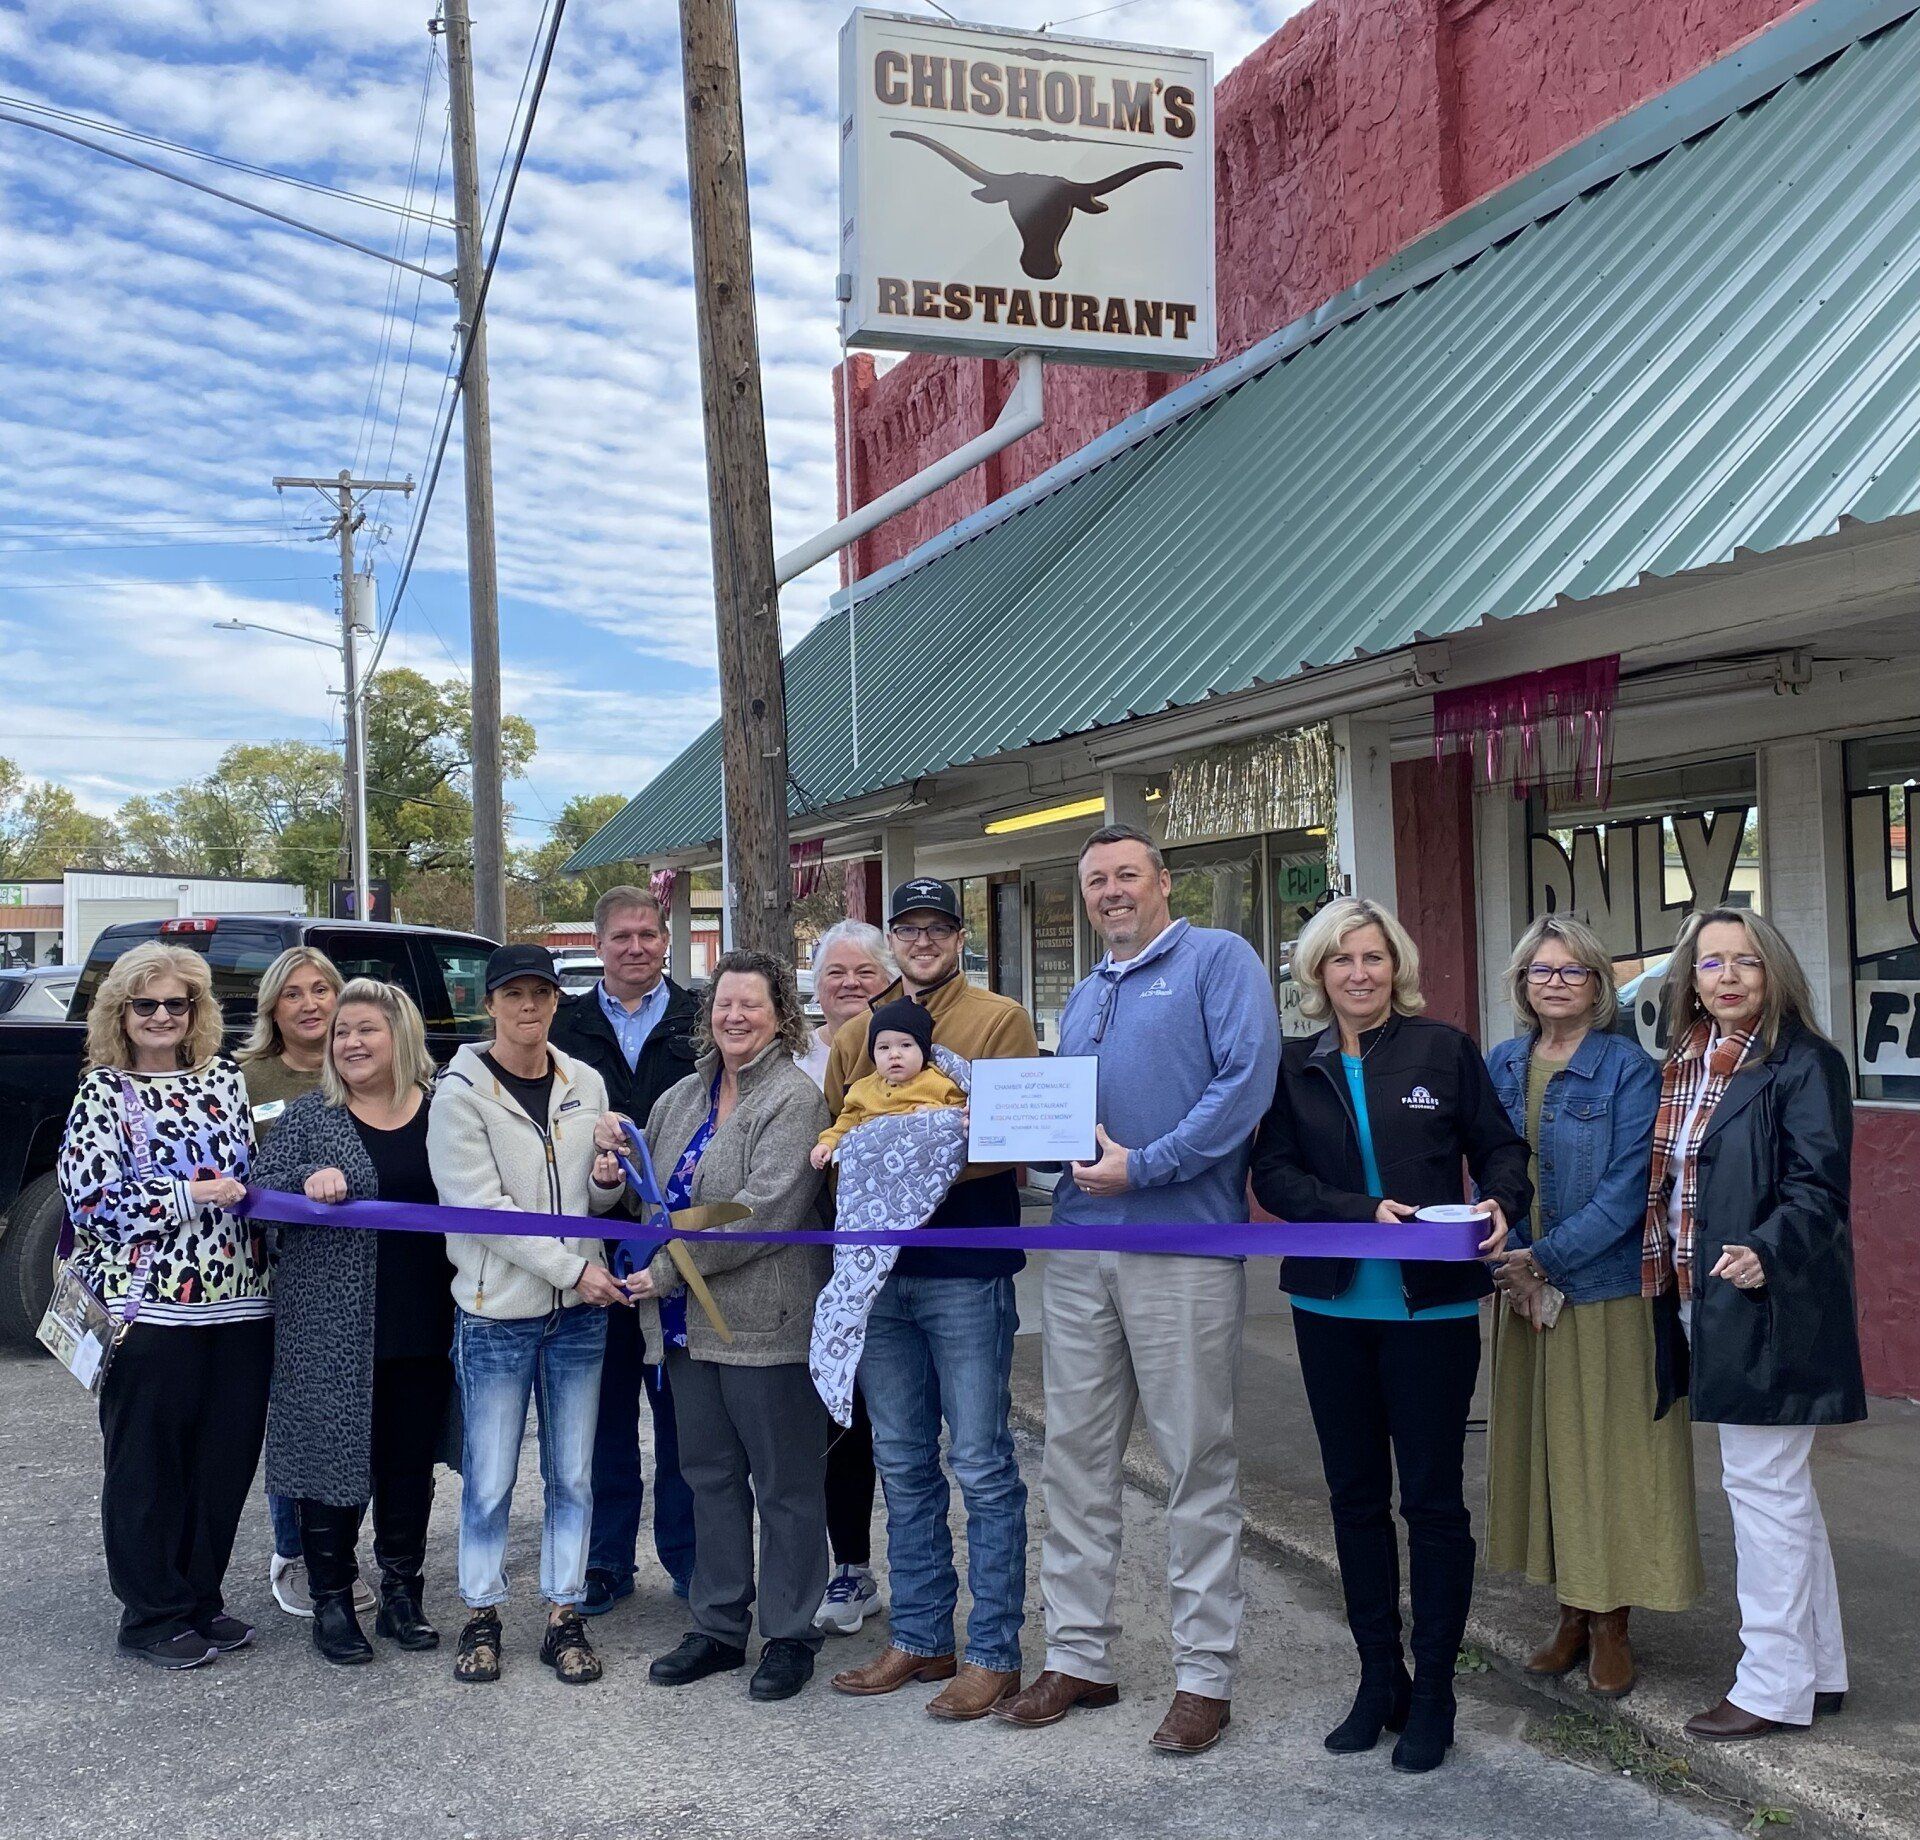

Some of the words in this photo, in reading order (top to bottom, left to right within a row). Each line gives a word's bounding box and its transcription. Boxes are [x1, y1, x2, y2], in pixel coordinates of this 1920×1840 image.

[874, 50, 1195, 139] CHISHOLM'S
[877, 277, 1196, 340] RESTAURANT
[1845, 785, 1920, 965] L
[126, 1101, 155, 1181] ILDCATS
[1401, 1097, 1439, 1105] FARMERS
